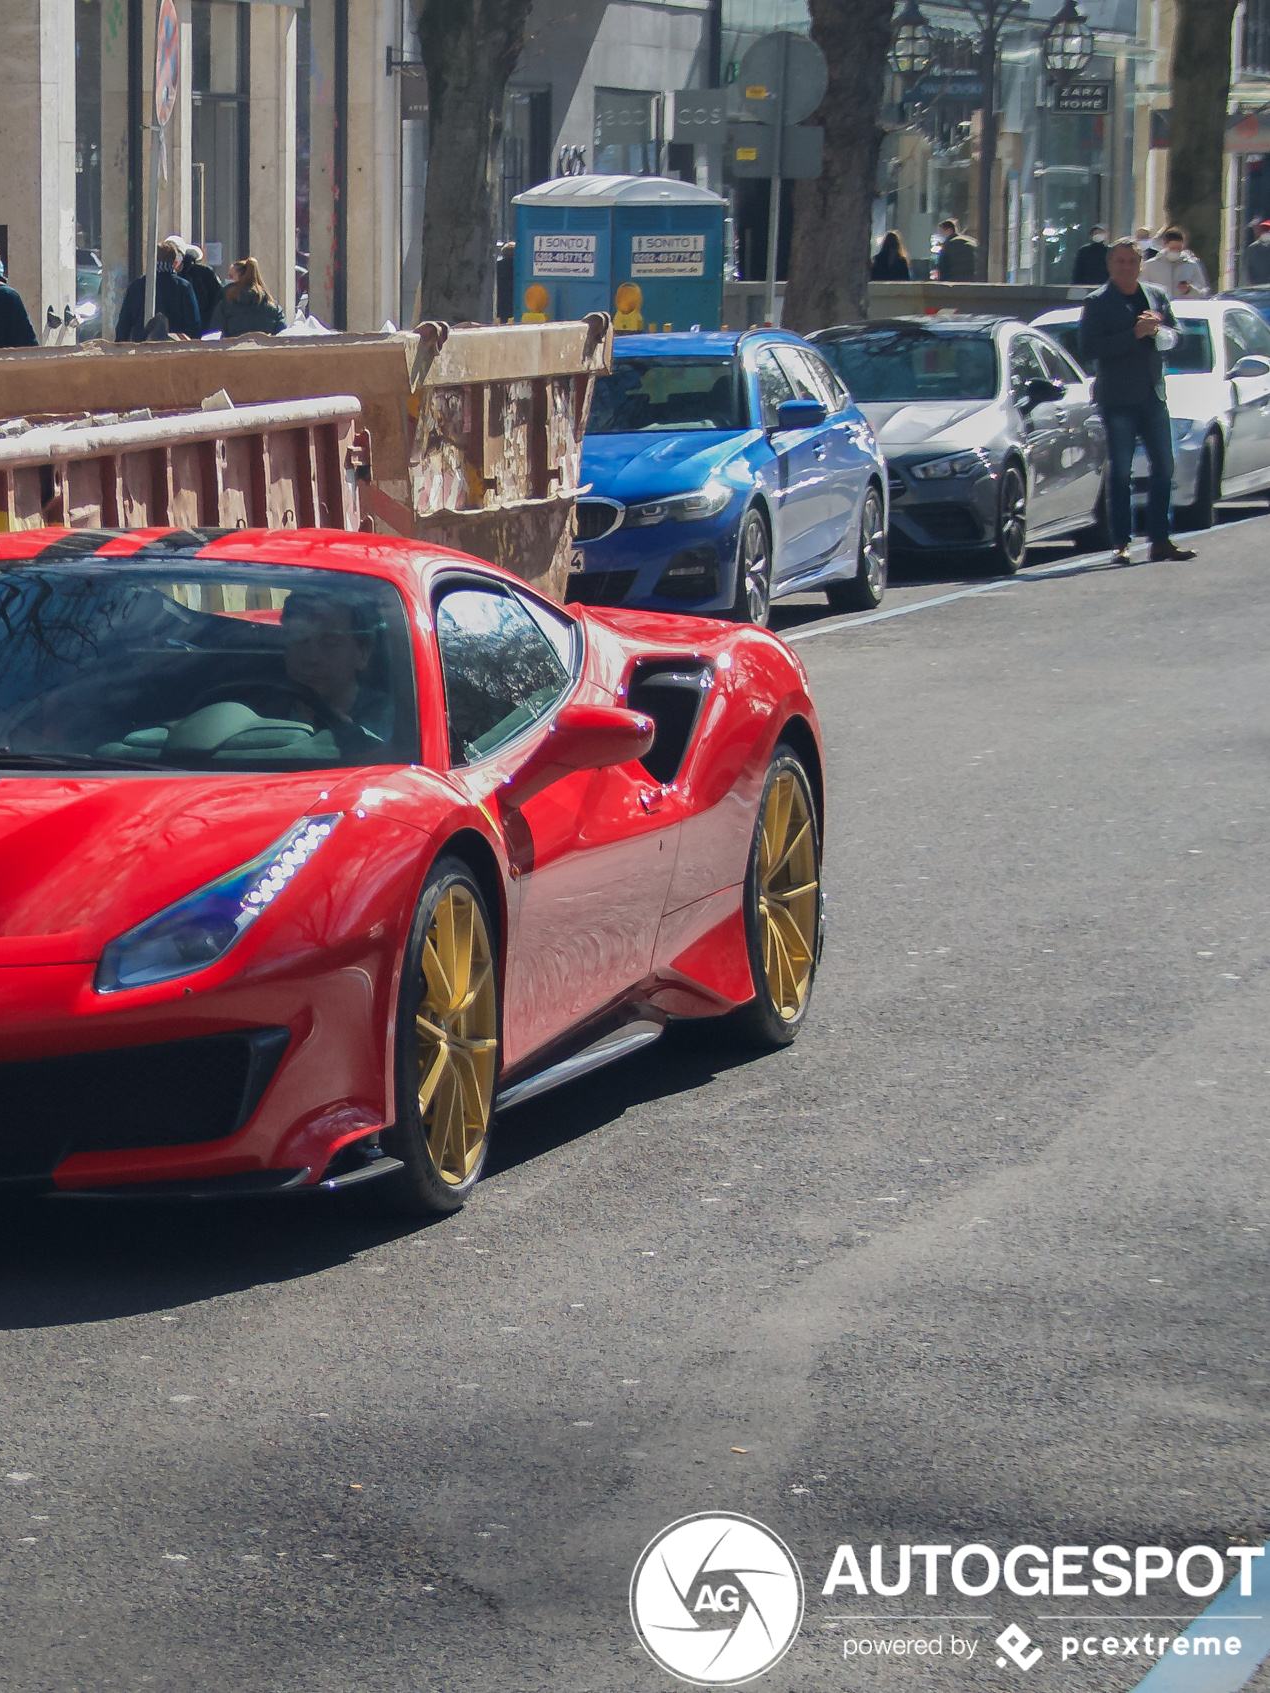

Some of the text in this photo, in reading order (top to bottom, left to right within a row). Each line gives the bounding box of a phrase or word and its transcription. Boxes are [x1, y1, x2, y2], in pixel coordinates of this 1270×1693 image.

[1061, 86, 1102, 97] ZARA
[1059, 100, 1102, 109] HOME
[678, 108, 722, 125] COS
[546, 238, 582, 248] SONITO
[646, 238, 690, 248] SONITO
